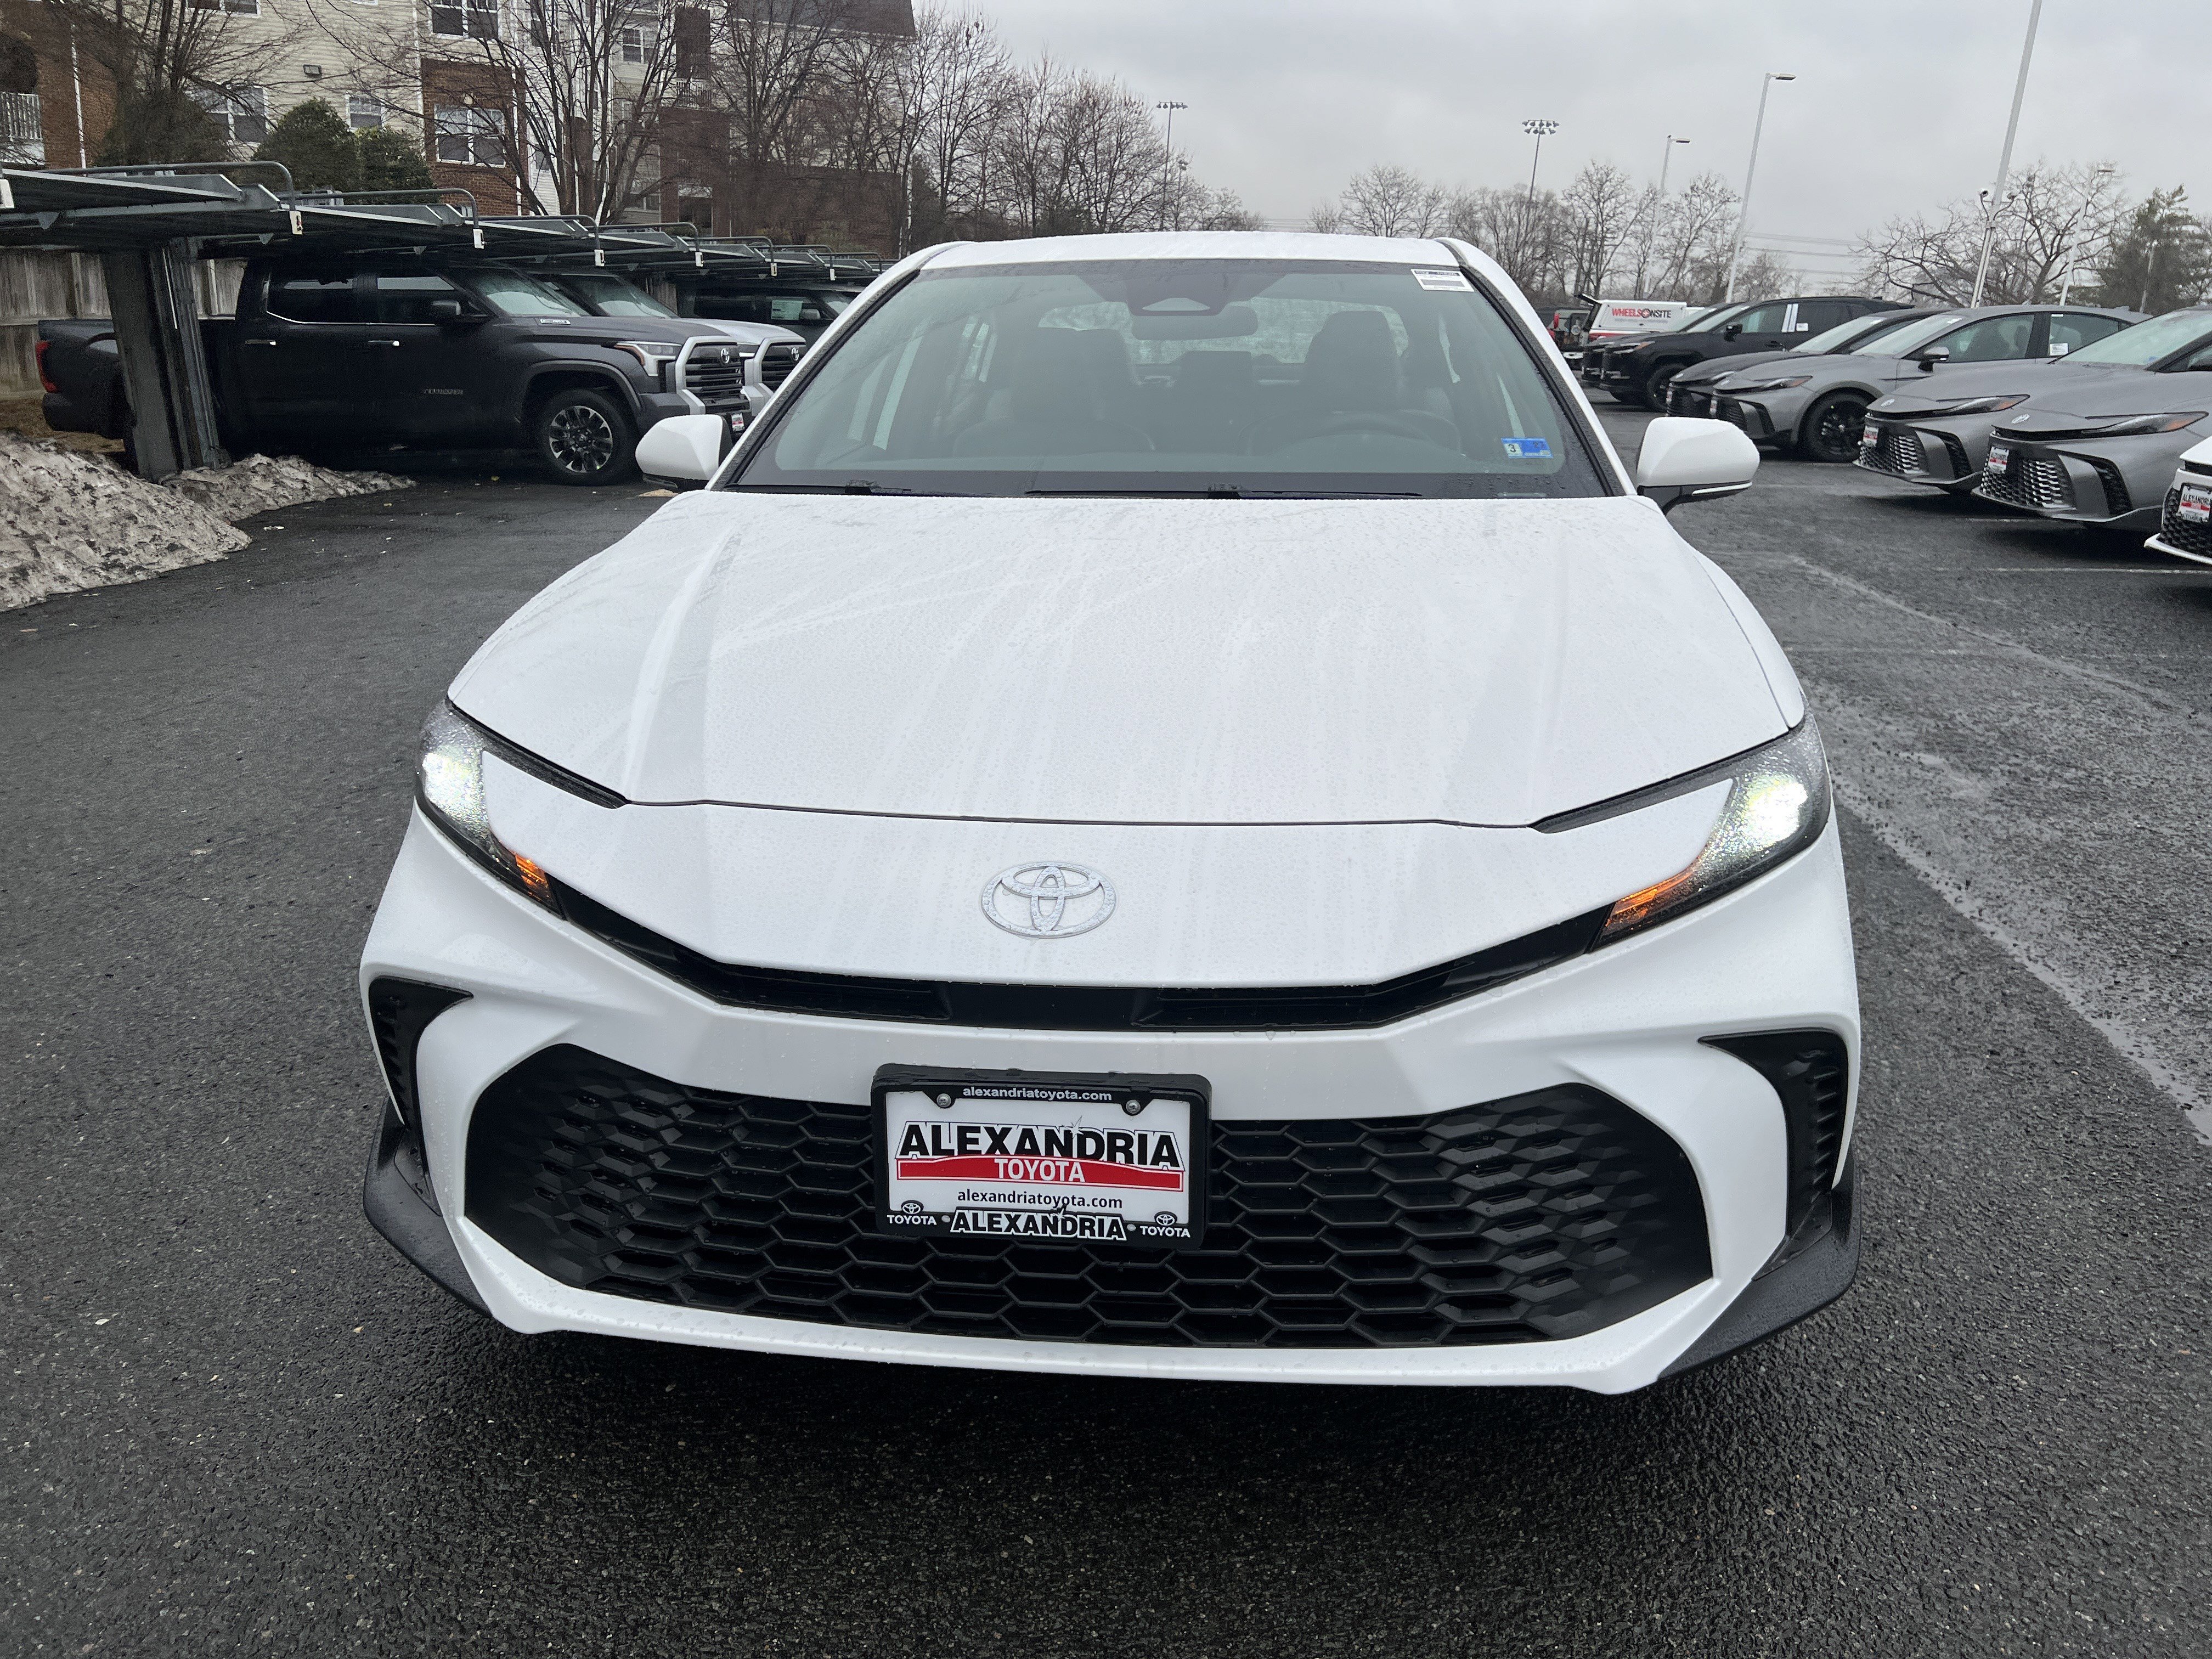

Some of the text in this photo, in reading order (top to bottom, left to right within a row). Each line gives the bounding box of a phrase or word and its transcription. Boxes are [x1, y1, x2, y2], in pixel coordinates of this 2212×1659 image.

[1508, 444, 1516, 453] 3
[963, 1086, 1112, 1101] alexandriatoyota.com
[898, 1123, 1181, 1168] ALEXANDRIA
[994, 1158, 1086, 1182] TOYOTA
[957, 1189, 1122, 1209] alexandriatoyota.com
[887, 1214, 937, 1226] TOYOTA
[951, 1210, 1126, 1240] ALEXANDRIA
[1139, 1225, 1191, 1238] TOYOTA
